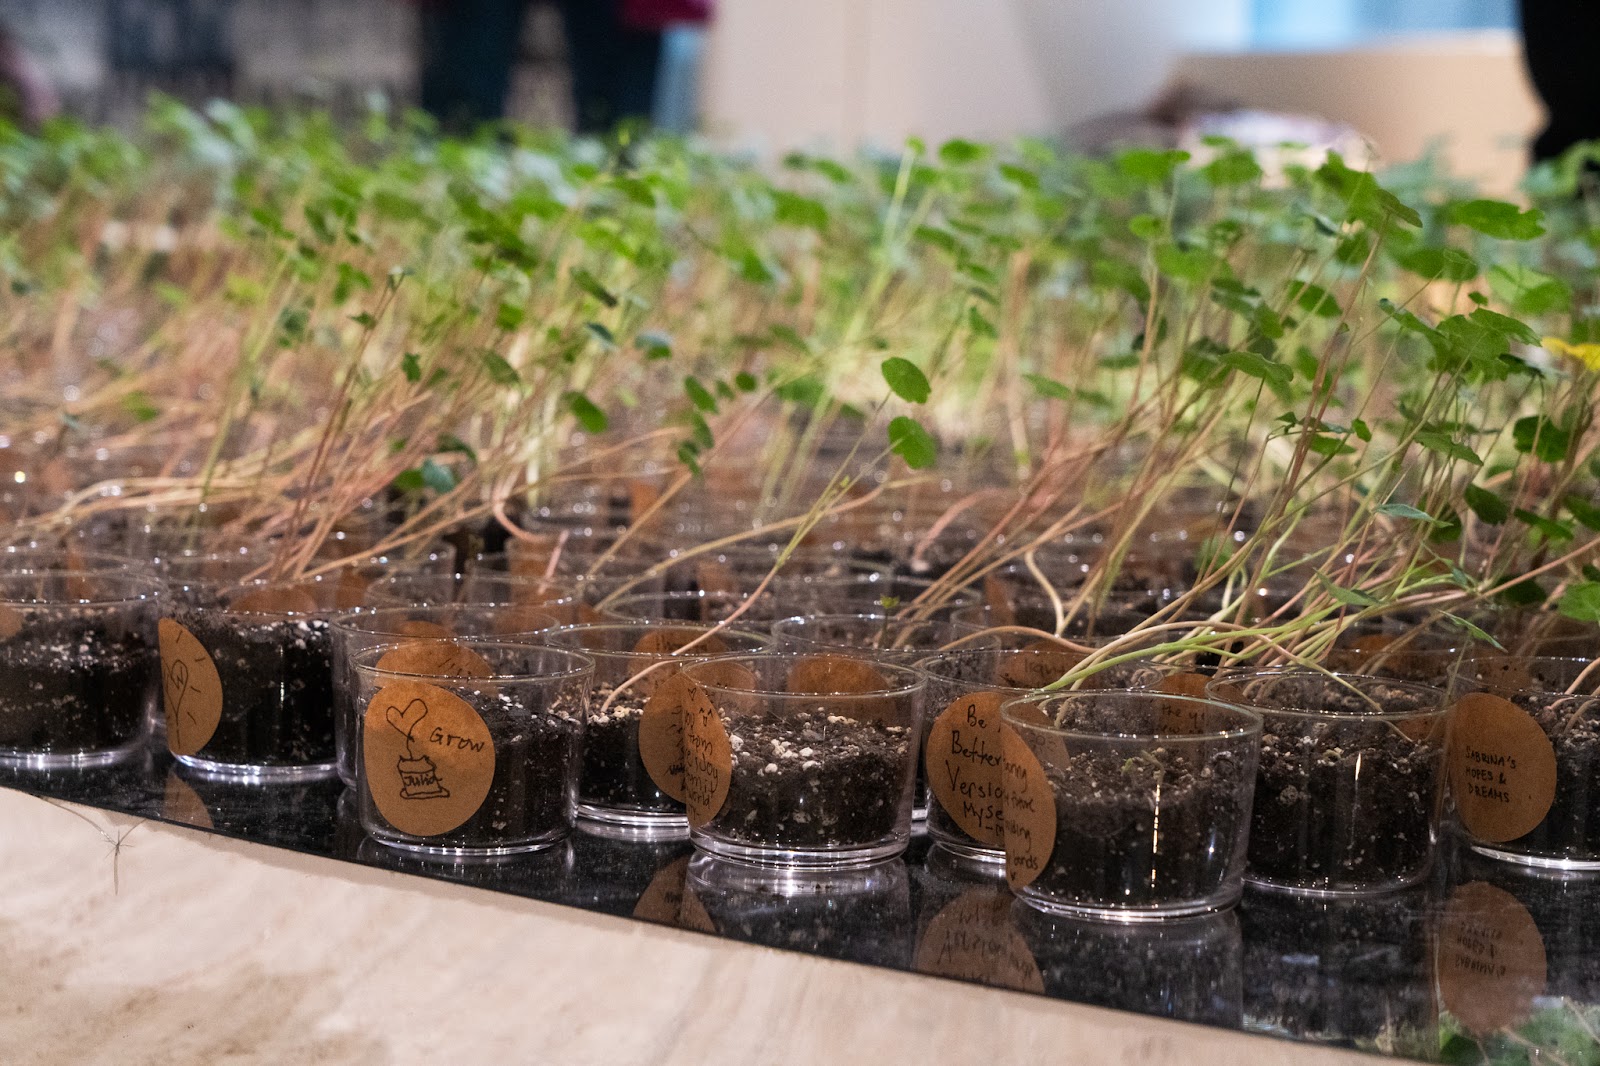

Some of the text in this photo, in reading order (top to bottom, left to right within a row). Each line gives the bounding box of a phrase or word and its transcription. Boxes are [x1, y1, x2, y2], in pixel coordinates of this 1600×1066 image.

[967, 703, 988, 729] Be
[429, 727, 486, 754] Grow
[951, 729, 1002, 767] Better
[1465, 747, 1517, 769] SABRINA'S
[1464, 767, 1494, 781] HOPES
[1467, 782, 1511, 803] DREAMS
